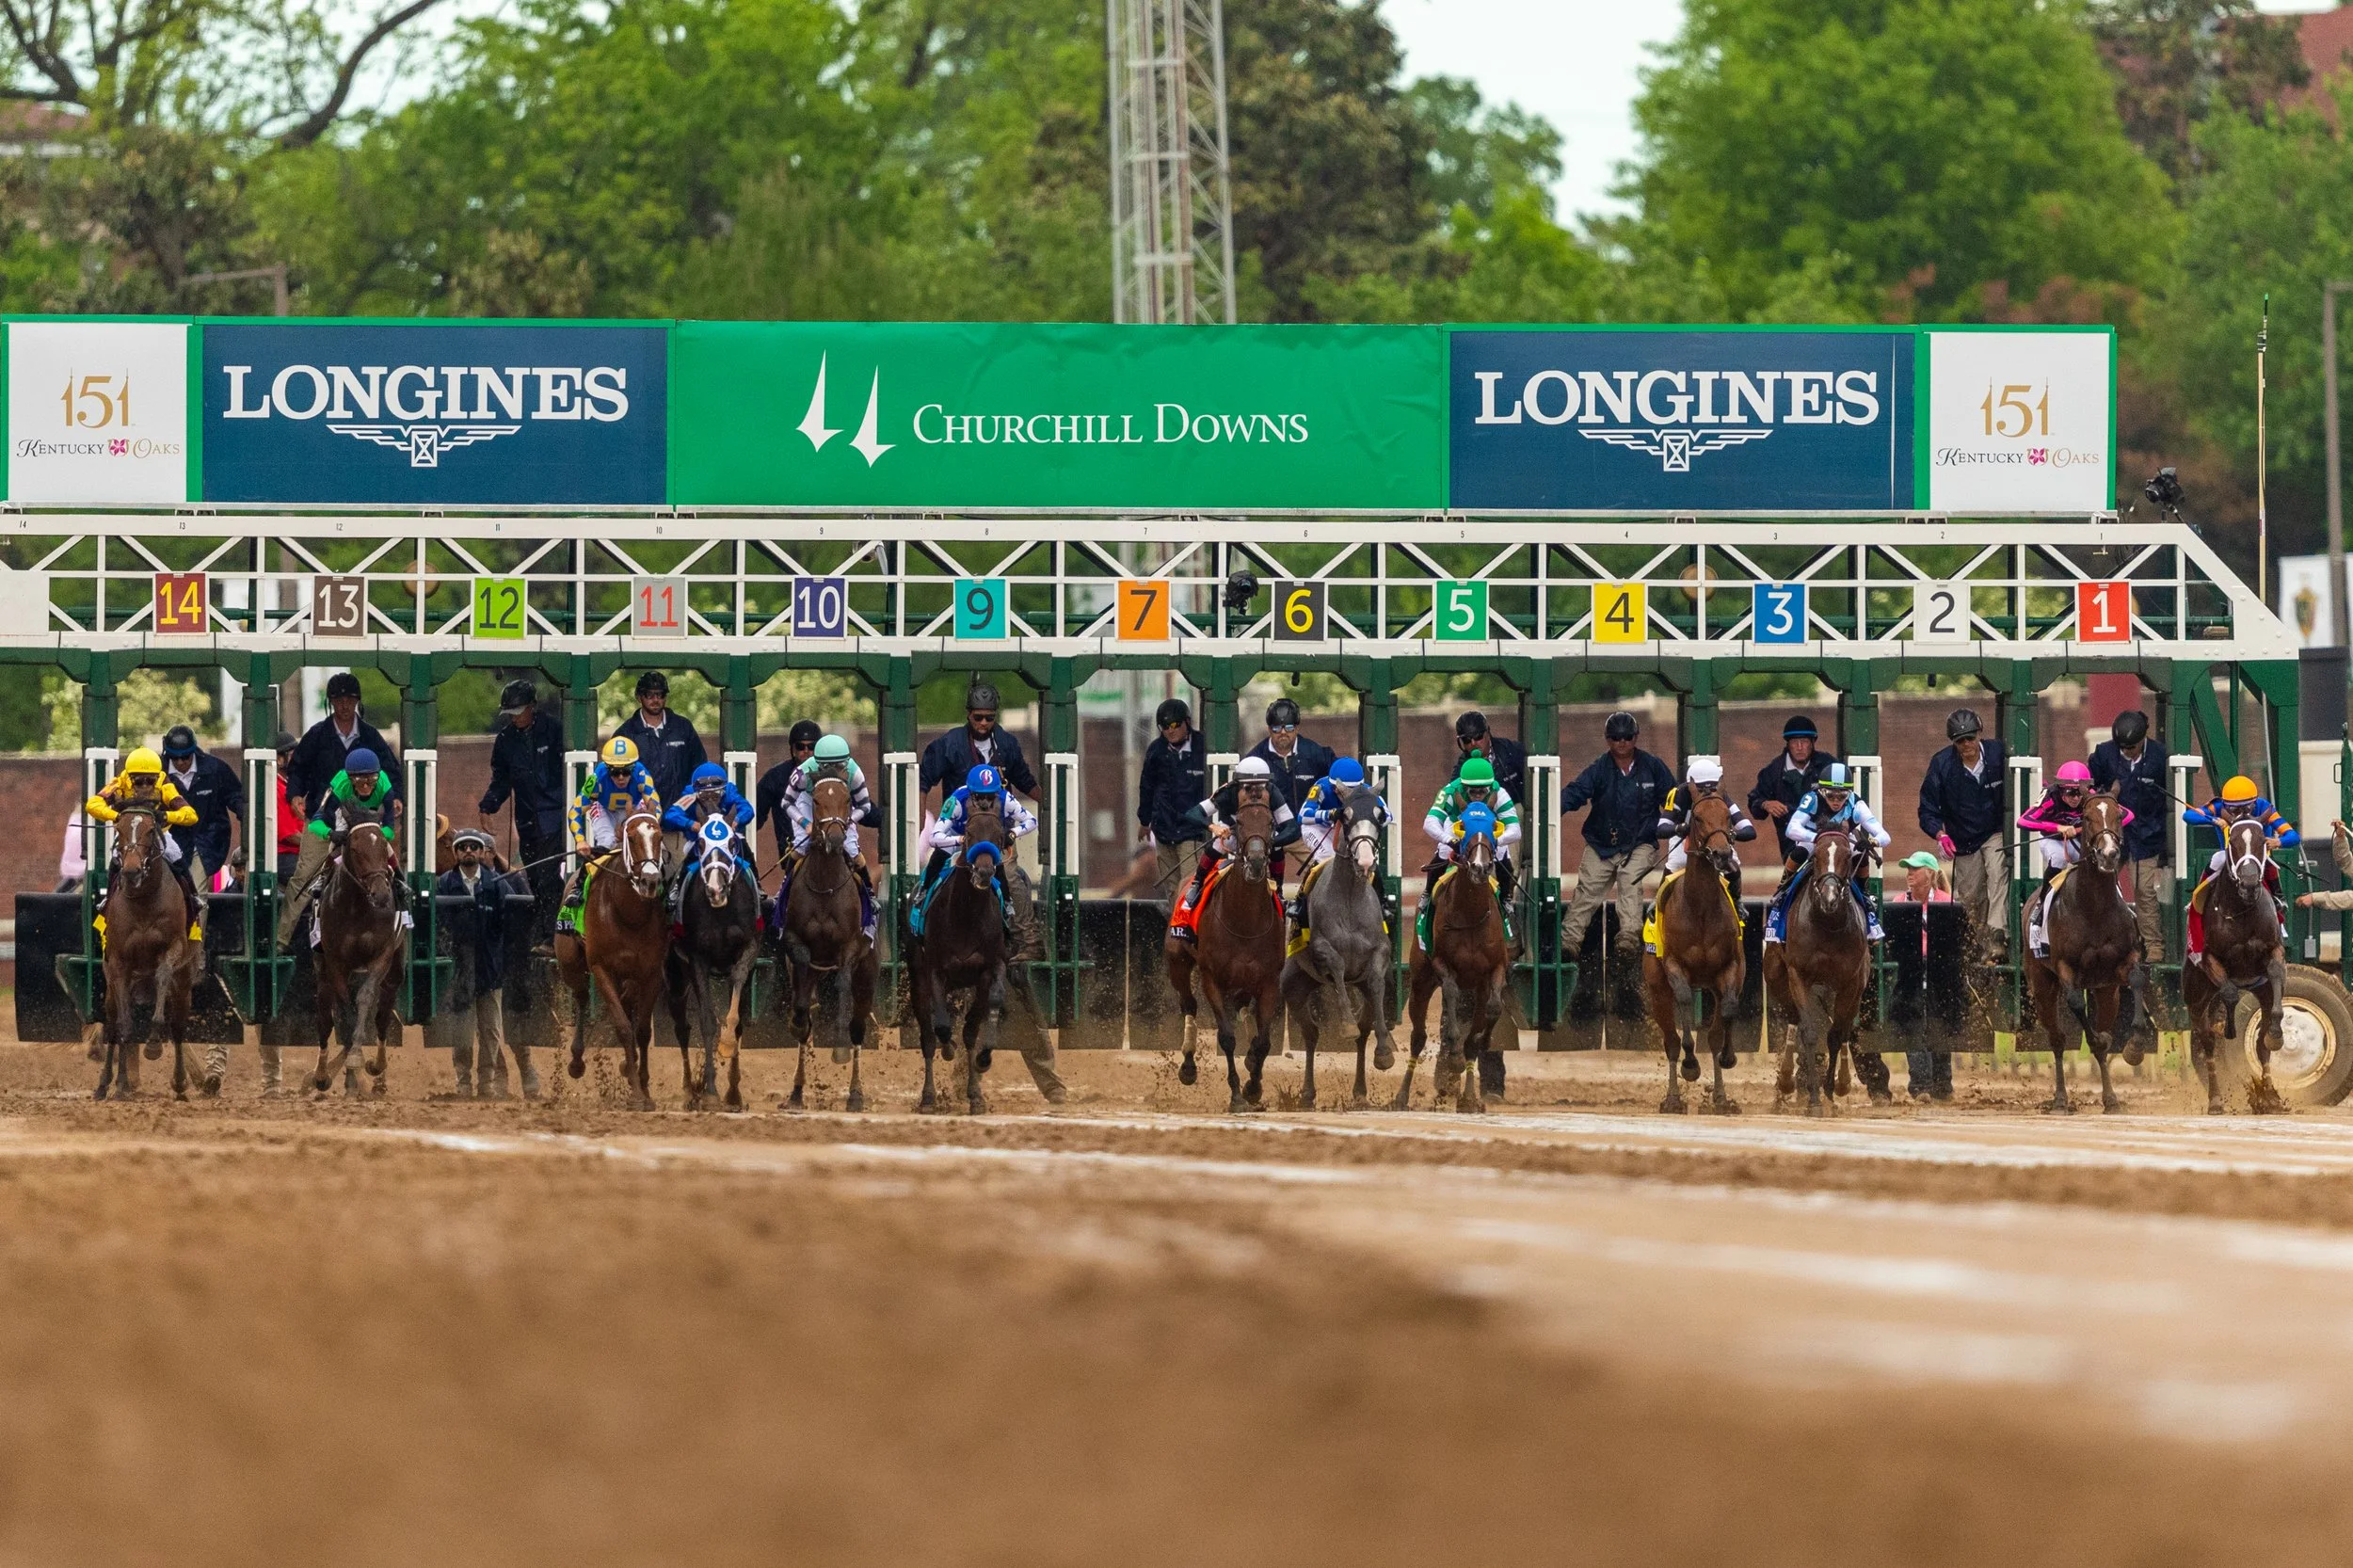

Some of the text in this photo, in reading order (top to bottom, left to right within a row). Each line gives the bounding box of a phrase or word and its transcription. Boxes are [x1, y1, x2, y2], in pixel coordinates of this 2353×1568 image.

[60, 368, 129, 428] 151
[223, 365, 628, 422] LONGINES
[1475, 370, 1879, 424] LONGINES
[1980, 376, 2049, 438] 151
[914, 404, 1307, 443] CHURCHILL DOWNS
[16, 438, 180, 458] KENTUCKY OAKS
[1936, 447, 2099, 469] KENTUCKY OAKS
[19, 520, 27, 528] 14
[179, 521, 186, 530] 13
[336, 522, 344, 531] 12
[656, 525, 664, 534] 10
[160, 582, 201, 624] 14
[318, 584, 359, 628] 13
[480, 587, 519, 629] 12
[640, 586, 678, 627] 11
[797, 585, 840, 630] 10
[966, 588, 994, 630] 9
[1130, 589, 1157, 631] 7
[1286, 589, 1313, 632] 6
[1449, 589, 1474, 632] 5
[1605, 592, 1634, 632] 4
[1767, 591, 1795, 634] 3
[1929, 591, 1955, 632] 2
[2092, 591, 2117, 632] 1
[615, 740, 627, 755] B
[1307, 785, 1320, 800] 6
[1435, 790, 1446, 805] 5
[1800, 794, 1813, 809] 3
